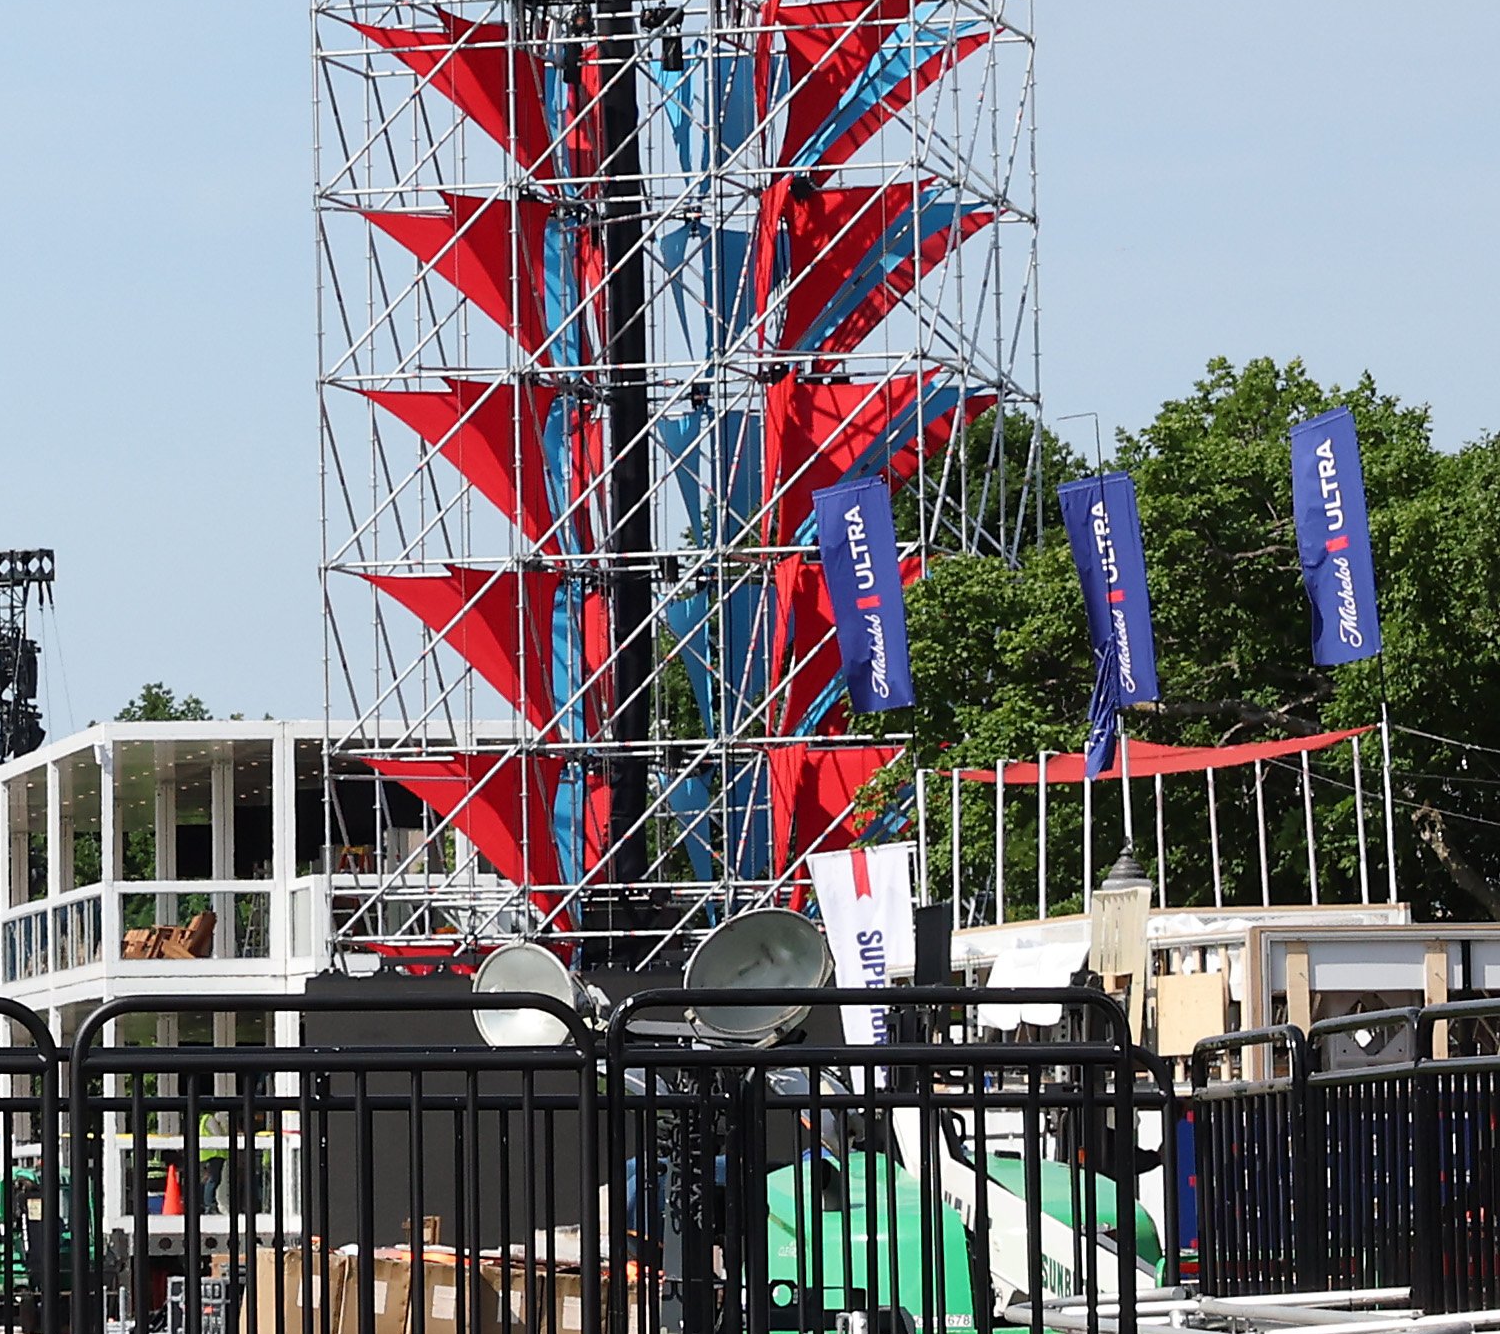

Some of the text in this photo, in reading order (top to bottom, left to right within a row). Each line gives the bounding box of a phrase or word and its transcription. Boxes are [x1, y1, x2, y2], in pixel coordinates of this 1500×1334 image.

[844, 505, 890, 698] Michelob ULTRA
[1315, 438, 1363, 648] Michelob ULTRA
